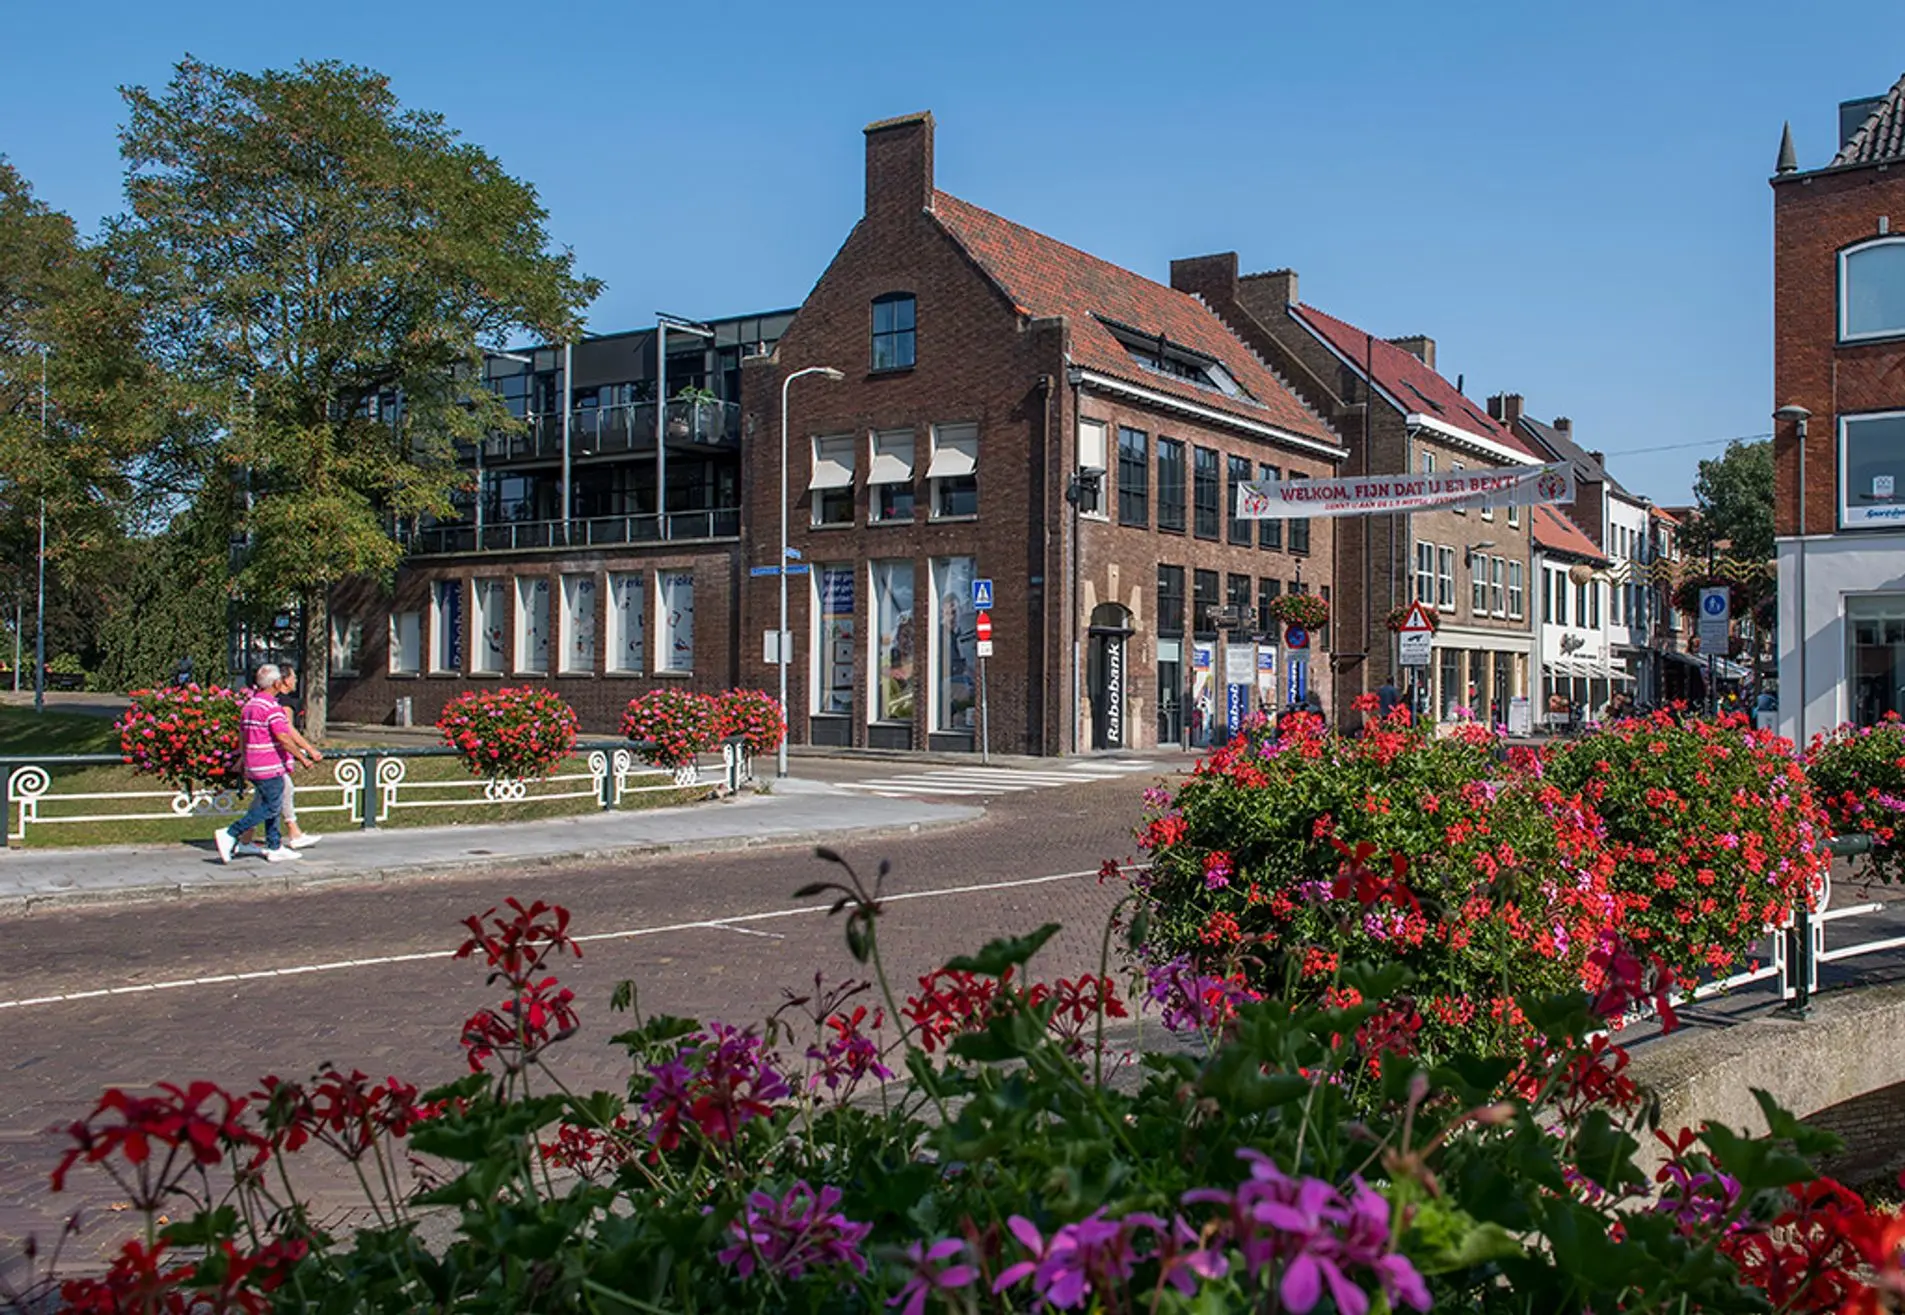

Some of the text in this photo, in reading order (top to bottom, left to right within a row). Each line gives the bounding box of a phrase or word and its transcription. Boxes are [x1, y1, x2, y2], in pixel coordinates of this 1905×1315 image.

[1280, 486, 1351, 502] WELKOM,
[1355, 483, 1389, 498] FIJN
[1394, 480, 1427, 496] DAT
[1428, 478, 1440, 493] U
[1445, 478, 1465, 493] ER
[1106, 642, 1120, 742] Rabobank
